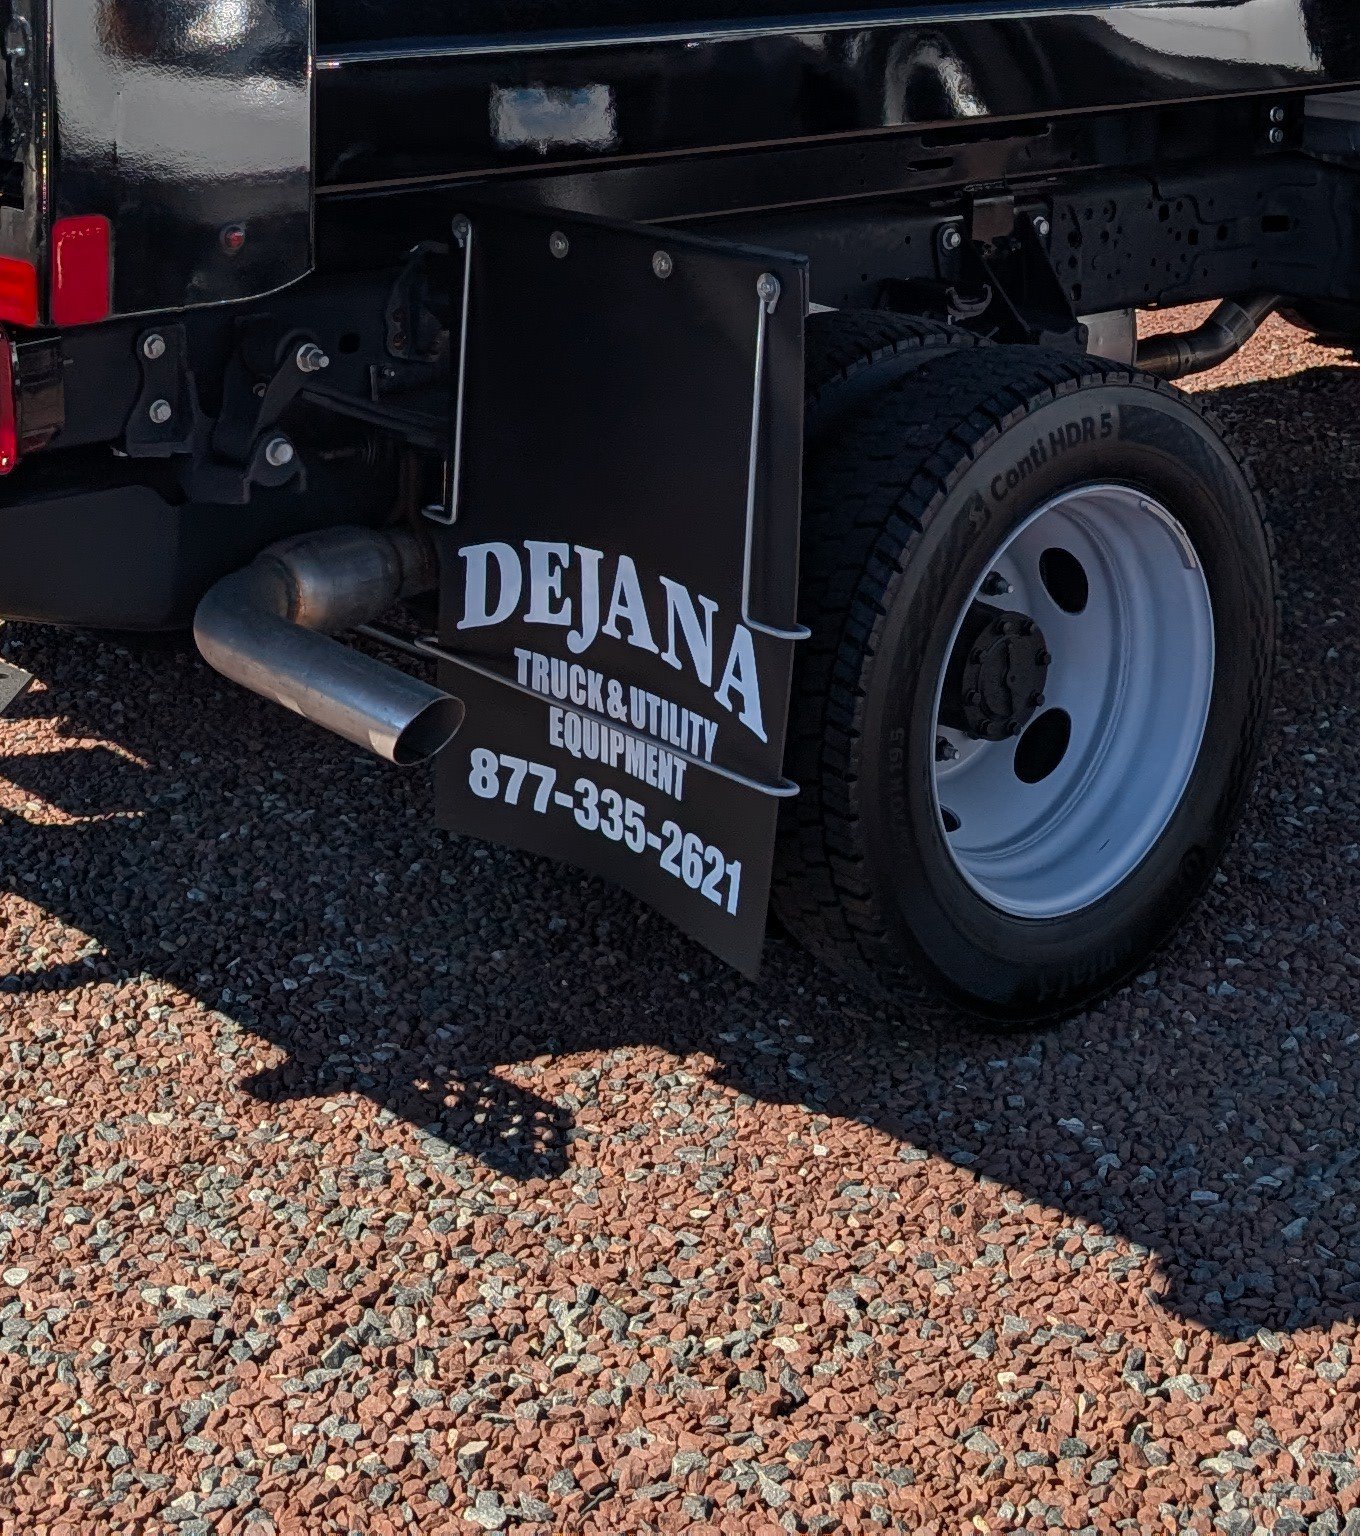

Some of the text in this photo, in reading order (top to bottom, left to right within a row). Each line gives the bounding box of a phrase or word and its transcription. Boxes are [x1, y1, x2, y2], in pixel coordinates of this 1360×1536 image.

[990, 412, 1113, 501] Conti HDR 5
[456, 539, 768, 744] DEJANA
[513, 647, 604, 715] TRUCK
[630, 688, 719, 763] UTILITY
[549, 707, 687, 801] EQUIPMENT
[468, 748, 742, 917] 877-335-2621
